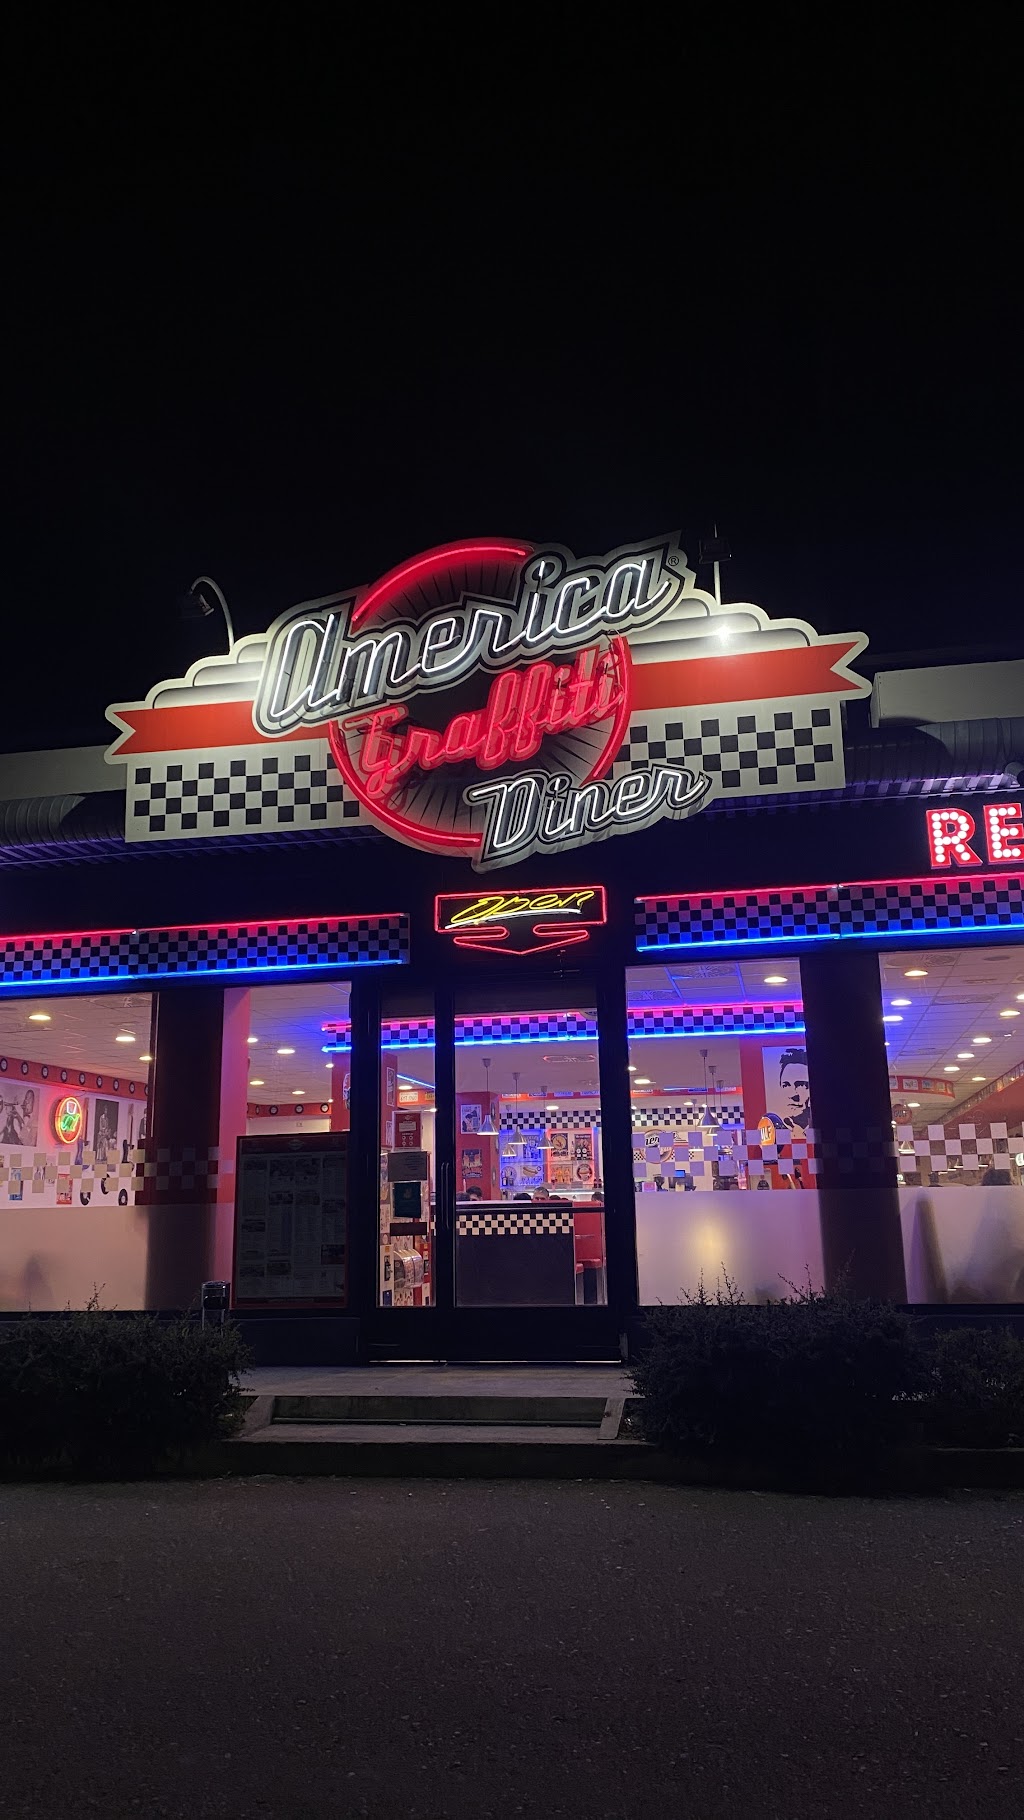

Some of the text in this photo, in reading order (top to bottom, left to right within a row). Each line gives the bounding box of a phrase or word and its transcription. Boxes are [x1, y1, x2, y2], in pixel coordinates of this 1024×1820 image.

[260, 552, 676, 727] America
[343, 647, 628, 798] Graffiti
[469, 767, 711, 858] Diner
[926, 802, 1024, 869] RE
